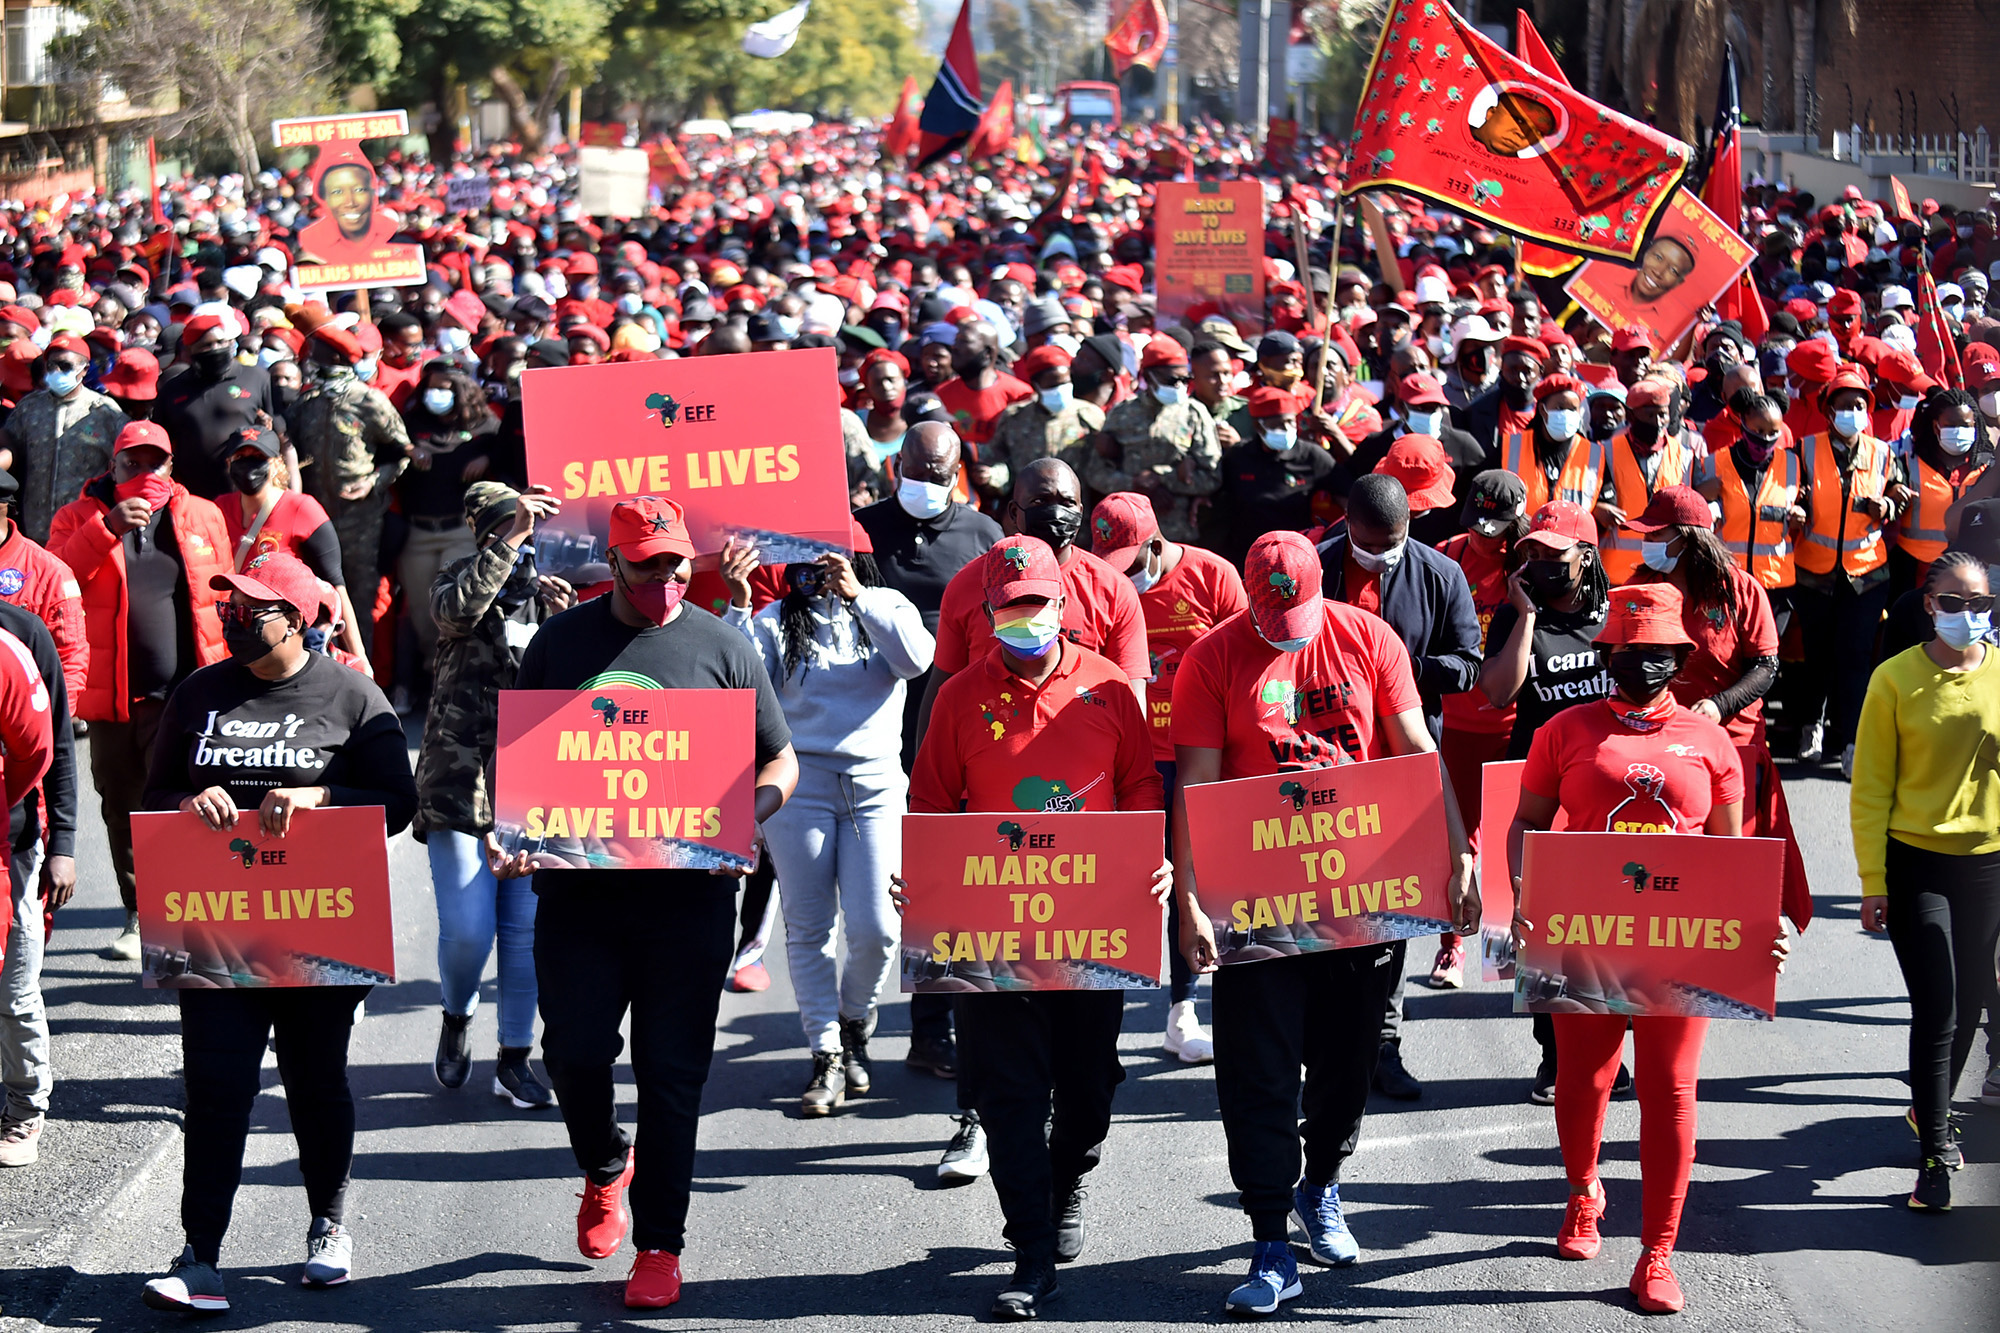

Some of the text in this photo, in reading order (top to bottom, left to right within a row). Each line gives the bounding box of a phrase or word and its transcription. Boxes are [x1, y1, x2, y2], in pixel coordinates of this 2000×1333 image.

[282, 119, 402, 145] SON OF THE SOIL
[1185, 199, 1235, 213] MARCH
[1202, 214, 1220, 229] TO
[1174, 230, 1247, 245] SAVE LIVES
[1682, 203, 1702, 221] OF
[1699, 217, 1724, 242] THE
[1718, 237, 1747, 265] SOIL
[300, 260, 421, 285] JULIUS MALEMA
[684, 404, 716, 422] EFF
[563, 444, 801, 500] SAVE LIVES
[1307, 681, 1355, 715] EFF
[1532, 669, 1616, 702] breath
[203, 710, 305, 739] I can't
[623, 710, 649, 724] EFF
[194, 736, 326, 769] breathe.
[557, 730, 689, 761] MARCH
[1268, 723, 1361, 764] VOTE
[603, 768, 648, 800] TO
[1311, 788, 1337, 804] EFF
[526, 806, 721, 838] SAVE LIVES
[1252, 803, 1382, 852] MARCH
[1029, 834, 1056, 848] EFF
[261, 850, 287, 865] EFF
[962, 854, 1096, 886] MARCH
[1300, 849, 1346, 883] TO
[1653, 876, 1680, 891] EFF
[165, 887, 355, 922] SAVE LIVES
[1009, 892, 1055, 924] TO
[1231, 875, 1422, 932] SAVE LIVES
[932, 928, 1128, 963] SAVE LIVES
[1546, 913, 1742, 950] SAVE LIVES
